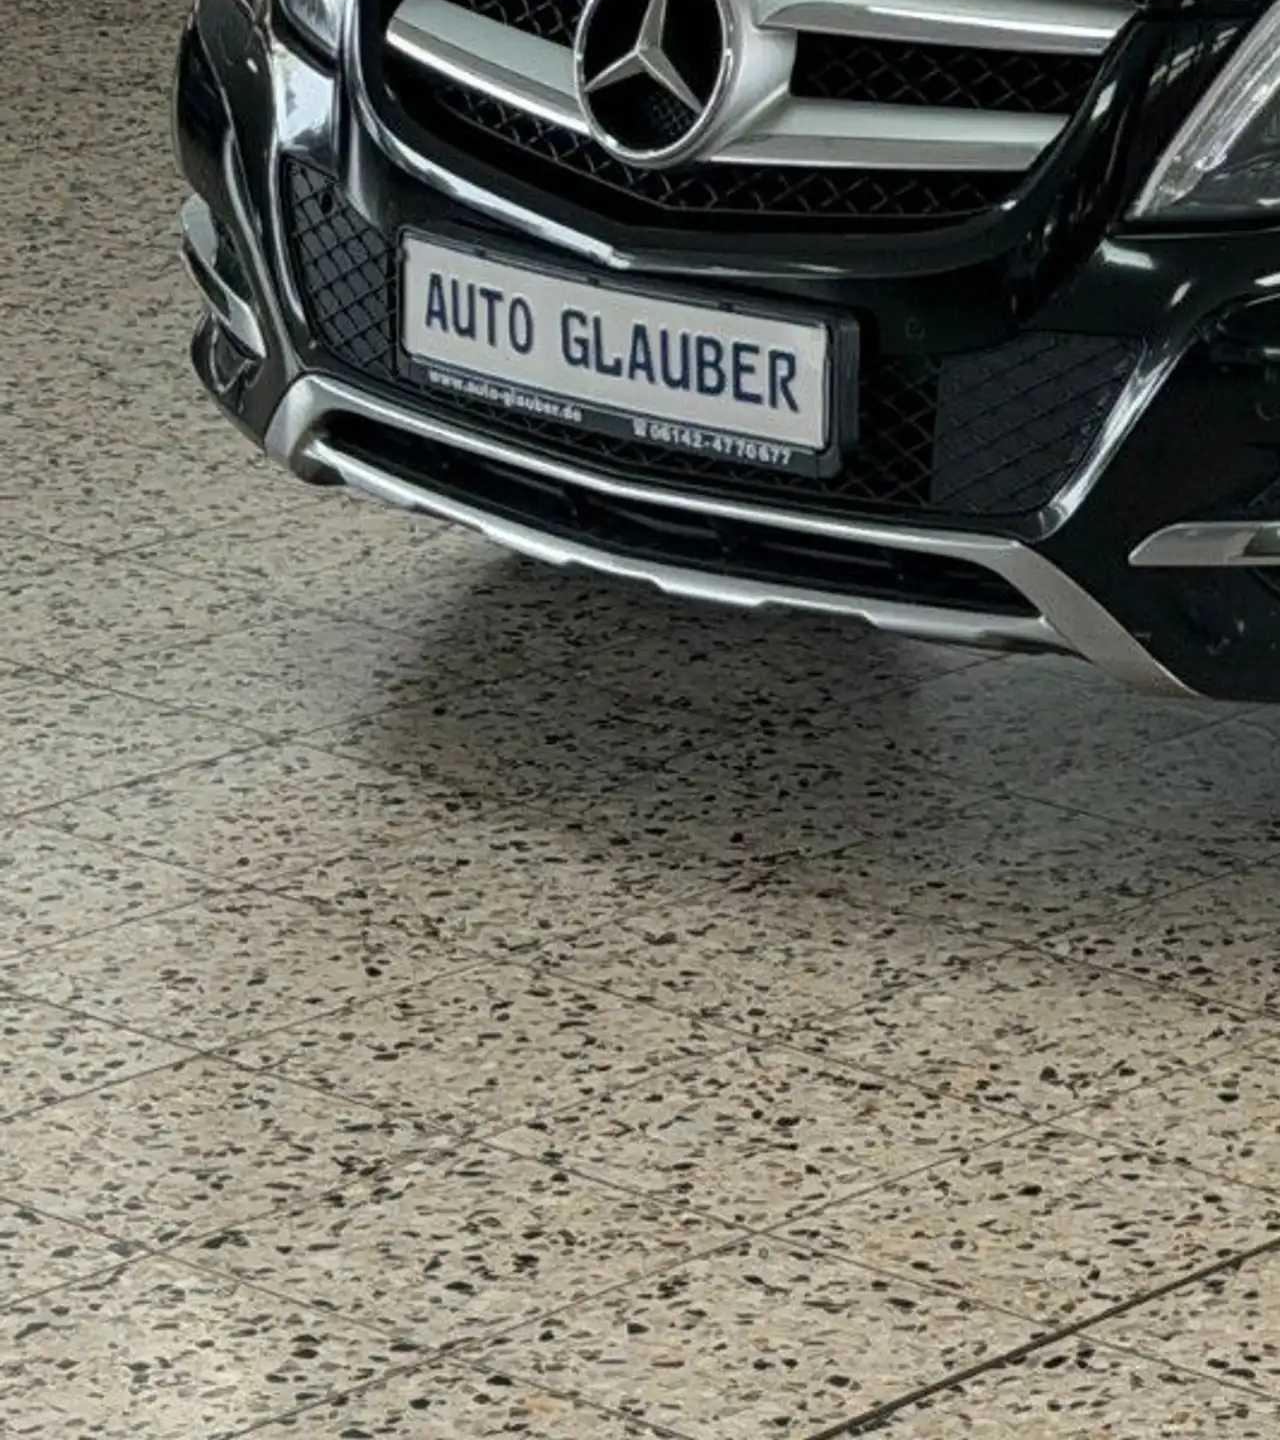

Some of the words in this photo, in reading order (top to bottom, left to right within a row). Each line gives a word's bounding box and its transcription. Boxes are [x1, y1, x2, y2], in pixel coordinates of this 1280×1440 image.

[425, 273, 535, 355] AUTO
[560, 309, 800, 413] GLAUBER
[429, 369, 583, 423] www.auto-glauber.de
